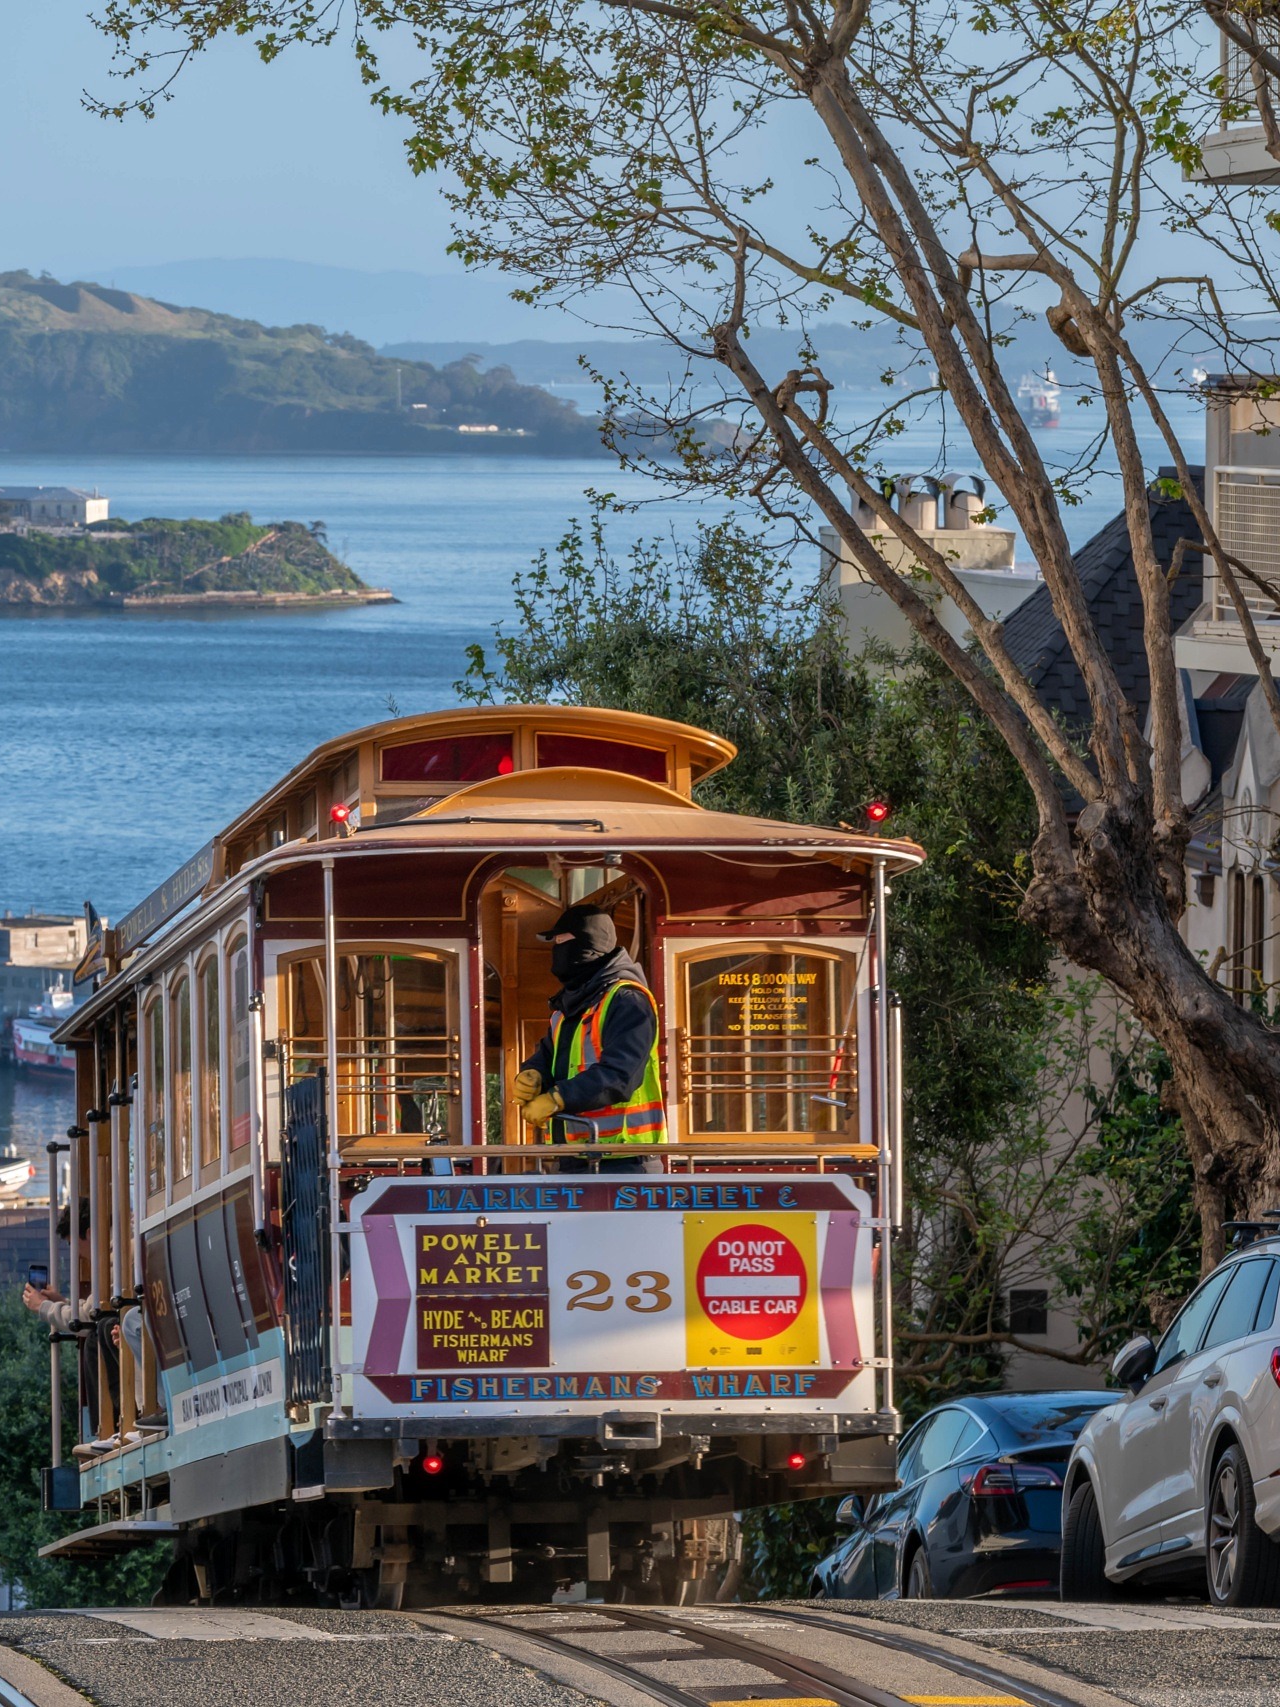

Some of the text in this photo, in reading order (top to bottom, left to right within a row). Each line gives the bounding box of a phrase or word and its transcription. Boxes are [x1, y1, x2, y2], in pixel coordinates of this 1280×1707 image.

[120, 902, 156, 949] POWELL
[161, 887, 168, 914] &
[172, 862, 197, 904] HYDE
[776, 973, 796, 985] ONE
[797, 973, 817, 985] WAY
[427, 1185, 797, 1211] MARKET STREET &
[422, 1233, 541, 1252] POWELL
[718, 1241, 786, 1256] DO NOT
[453, 1252, 512, 1265] AND
[729, 1257, 775, 1273] PASS
[420, 1266, 543, 1285] MARKET
[152, 1280, 167, 1316] 23
[566, 1270, 672, 1313] 23
[708, 1300, 797, 1315] CABLE CAR
[423, 1309, 544, 1330] HYDE AND BEACH
[433, 1333, 533, 1348] FISHERMANS
[457, 1349, 509, 1363] WHARF
[182, 1397, 193, 1422] SAN
[222, 1379, 248, 1406] UNICIPAL
[253, 1370, 272, 1399] AILWAY
[411, 1373, 816, 1401] FISHERMANS WHARF
